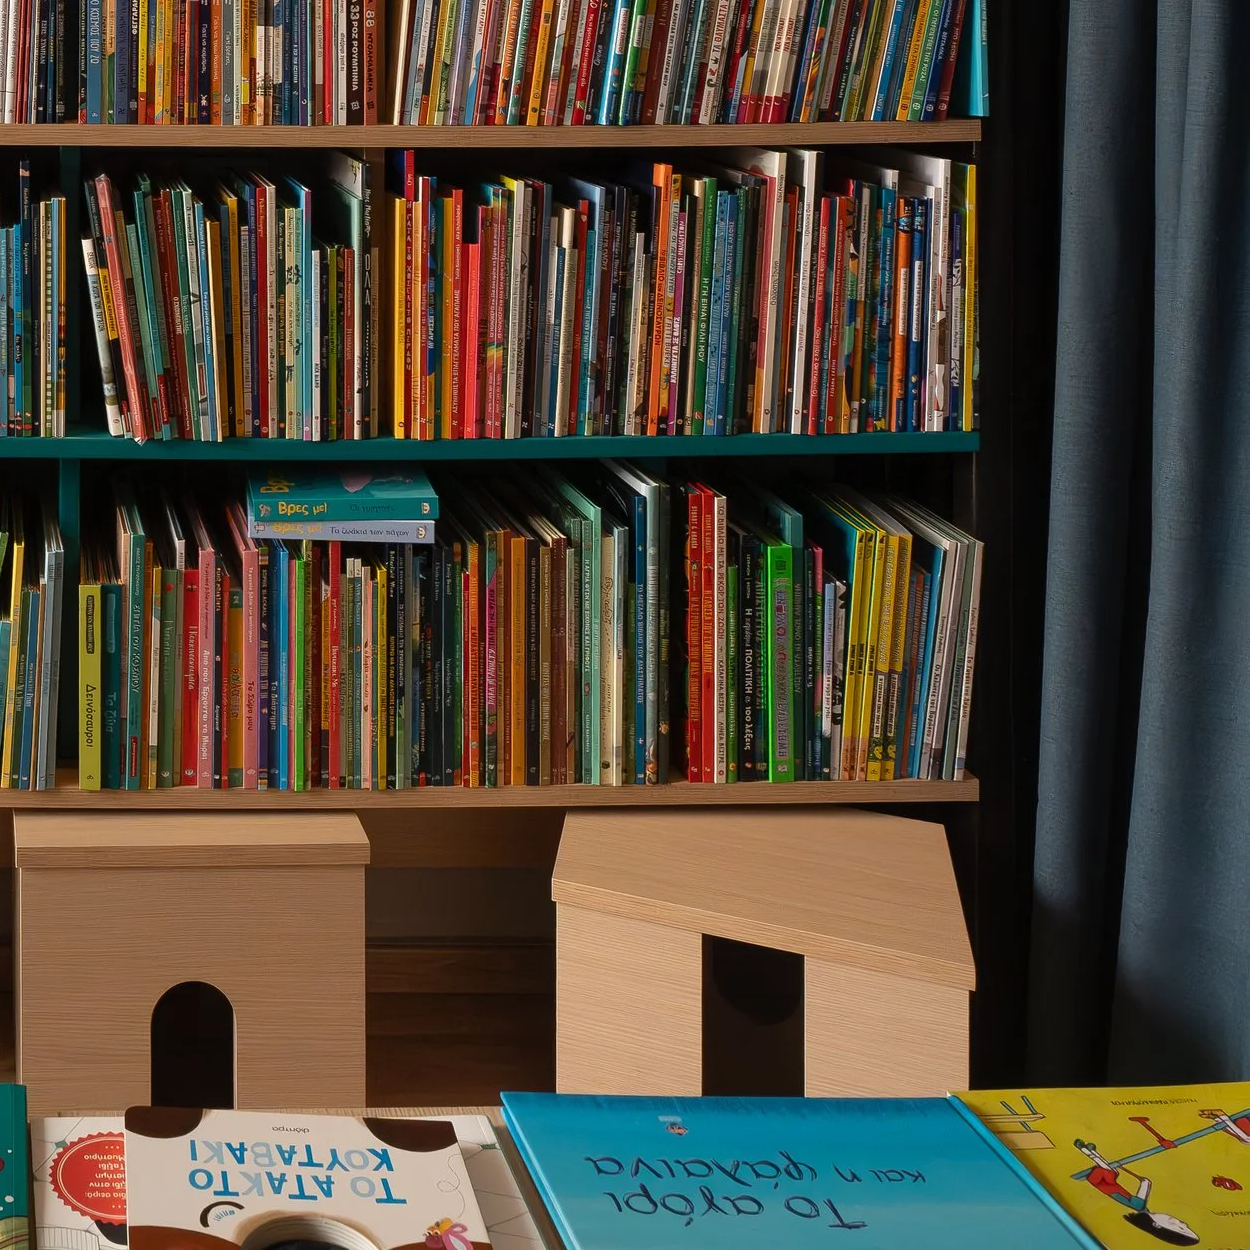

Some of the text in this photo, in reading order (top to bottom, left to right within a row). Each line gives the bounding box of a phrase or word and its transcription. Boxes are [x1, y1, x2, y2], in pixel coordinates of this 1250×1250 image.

[350, 5, 361, 20] 33
[366, 9, 376, 28] 88
[714, 5, 729, 43] ΘΑΥΜΑΣΤΑ
[712, 45, 721, 54] ΤΑ
[677, 221, 686, 253] HAUGHTON
[278, 502, 309, 516] Βρες
[330, 527, 339, 535] Τα
[341, 527, 368, 536] ζωάκια
[717, 506, 725, 640] ΤΟ ΒΙΒΛΙΟ ΜΕ ΤΑ ΡΕΚΟΡ ΤΩΝ ΖΩΩΝ
[84, 684, 96, 748] Δεινόσαυροι
[272, 1124, 310, 1134] διόπτρα
[189, 1139, 395, 1172] ΚΟΥΤΑΒΑΚΙ
[585, 1150, 927, 1191] και η φάλαινα
[188, 1168, 408, 1205] ΤΟ ΑΤΑΚΤΟ
[604, 1189, 869, 1230] Το αγόρι
